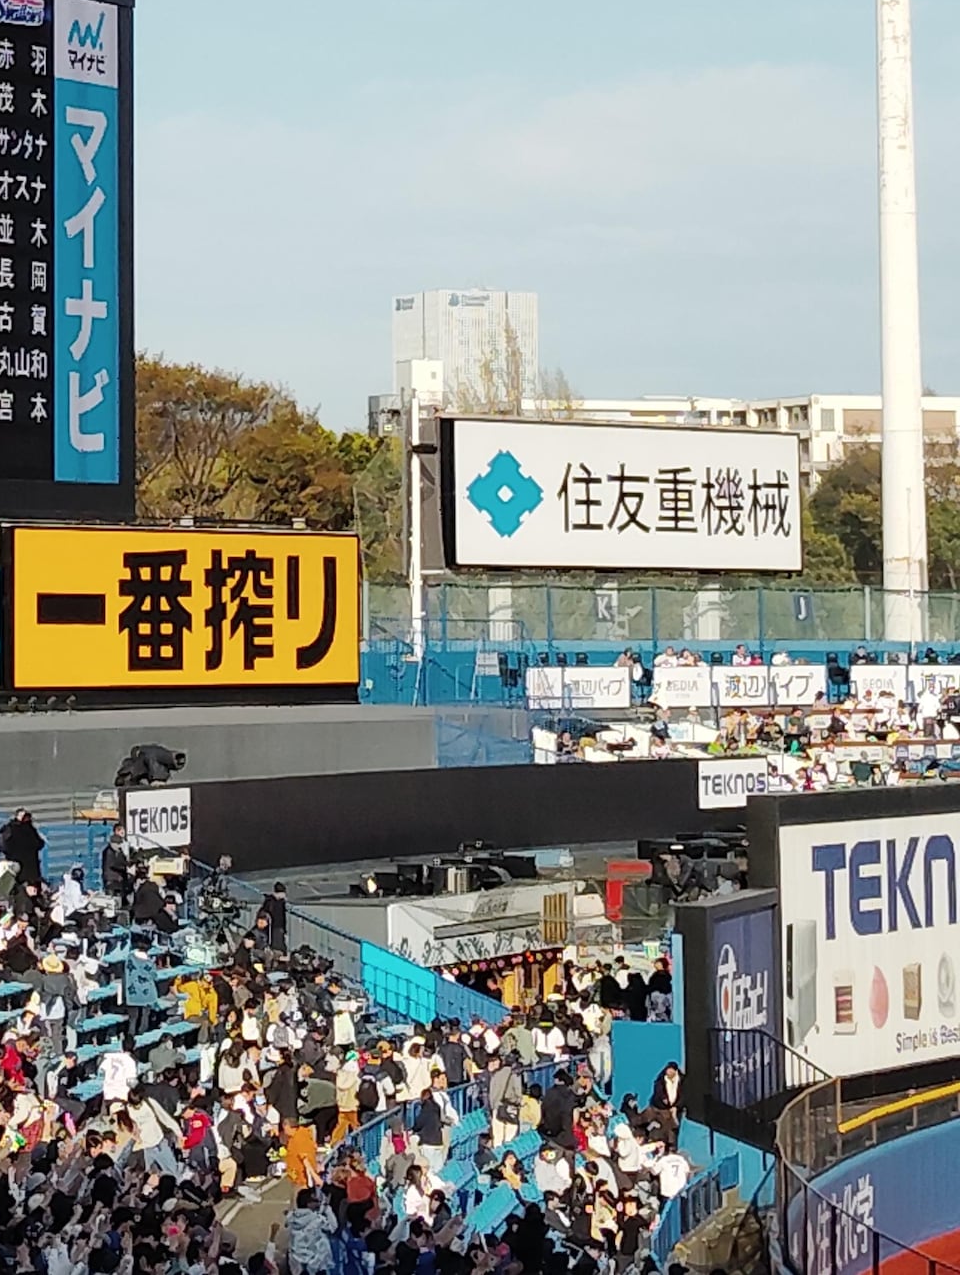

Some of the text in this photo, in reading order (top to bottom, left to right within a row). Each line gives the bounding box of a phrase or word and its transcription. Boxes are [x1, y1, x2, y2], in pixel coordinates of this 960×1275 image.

[68, 49, 106, 74] マイナビ
[65, 106, 110, 453] マイナビ
[557, 462, 791, 537] 住友重機械
[37, 549, 338, 670] 一番搾り
[597, 596, 612, 619] K
[797, 596, 807, 621] J
[701, 772, 766, 796] TEKNOS
[129, 804, 189, 835] TEKNOS
[896, 1029, 928, 1054] Simple
[929, 1028, 938, 1046] is
